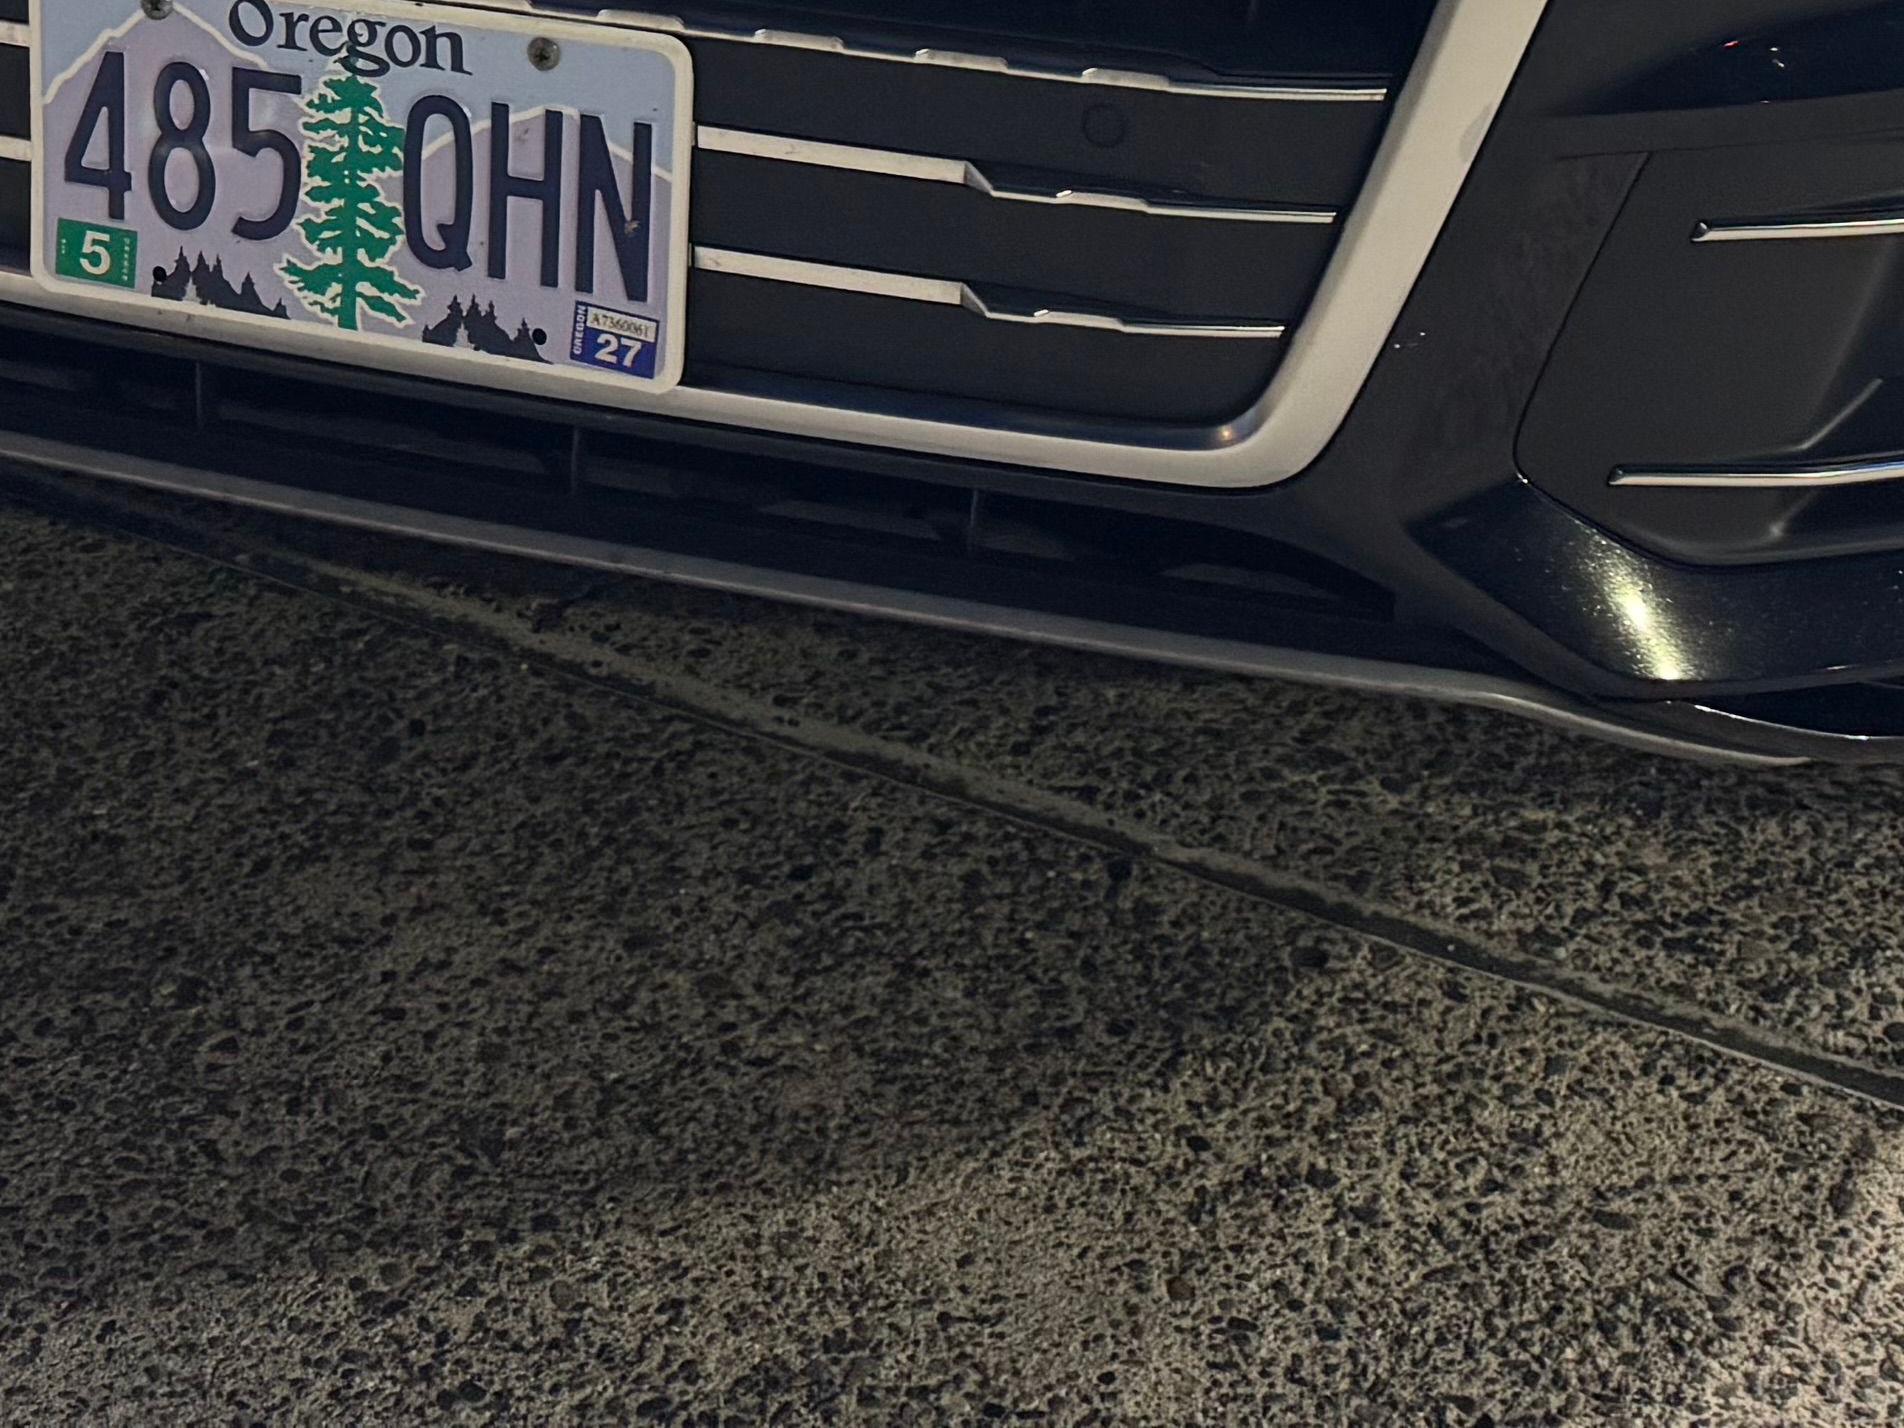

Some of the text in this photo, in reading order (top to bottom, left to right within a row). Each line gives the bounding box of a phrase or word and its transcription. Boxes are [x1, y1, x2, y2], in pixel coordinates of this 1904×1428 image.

[64, 51, 653, 303] 485 QHN
[79, 230, 111, 275] 5
[573, 304, 587, 355] OREGON
[594, 332, 642, 368] 27
